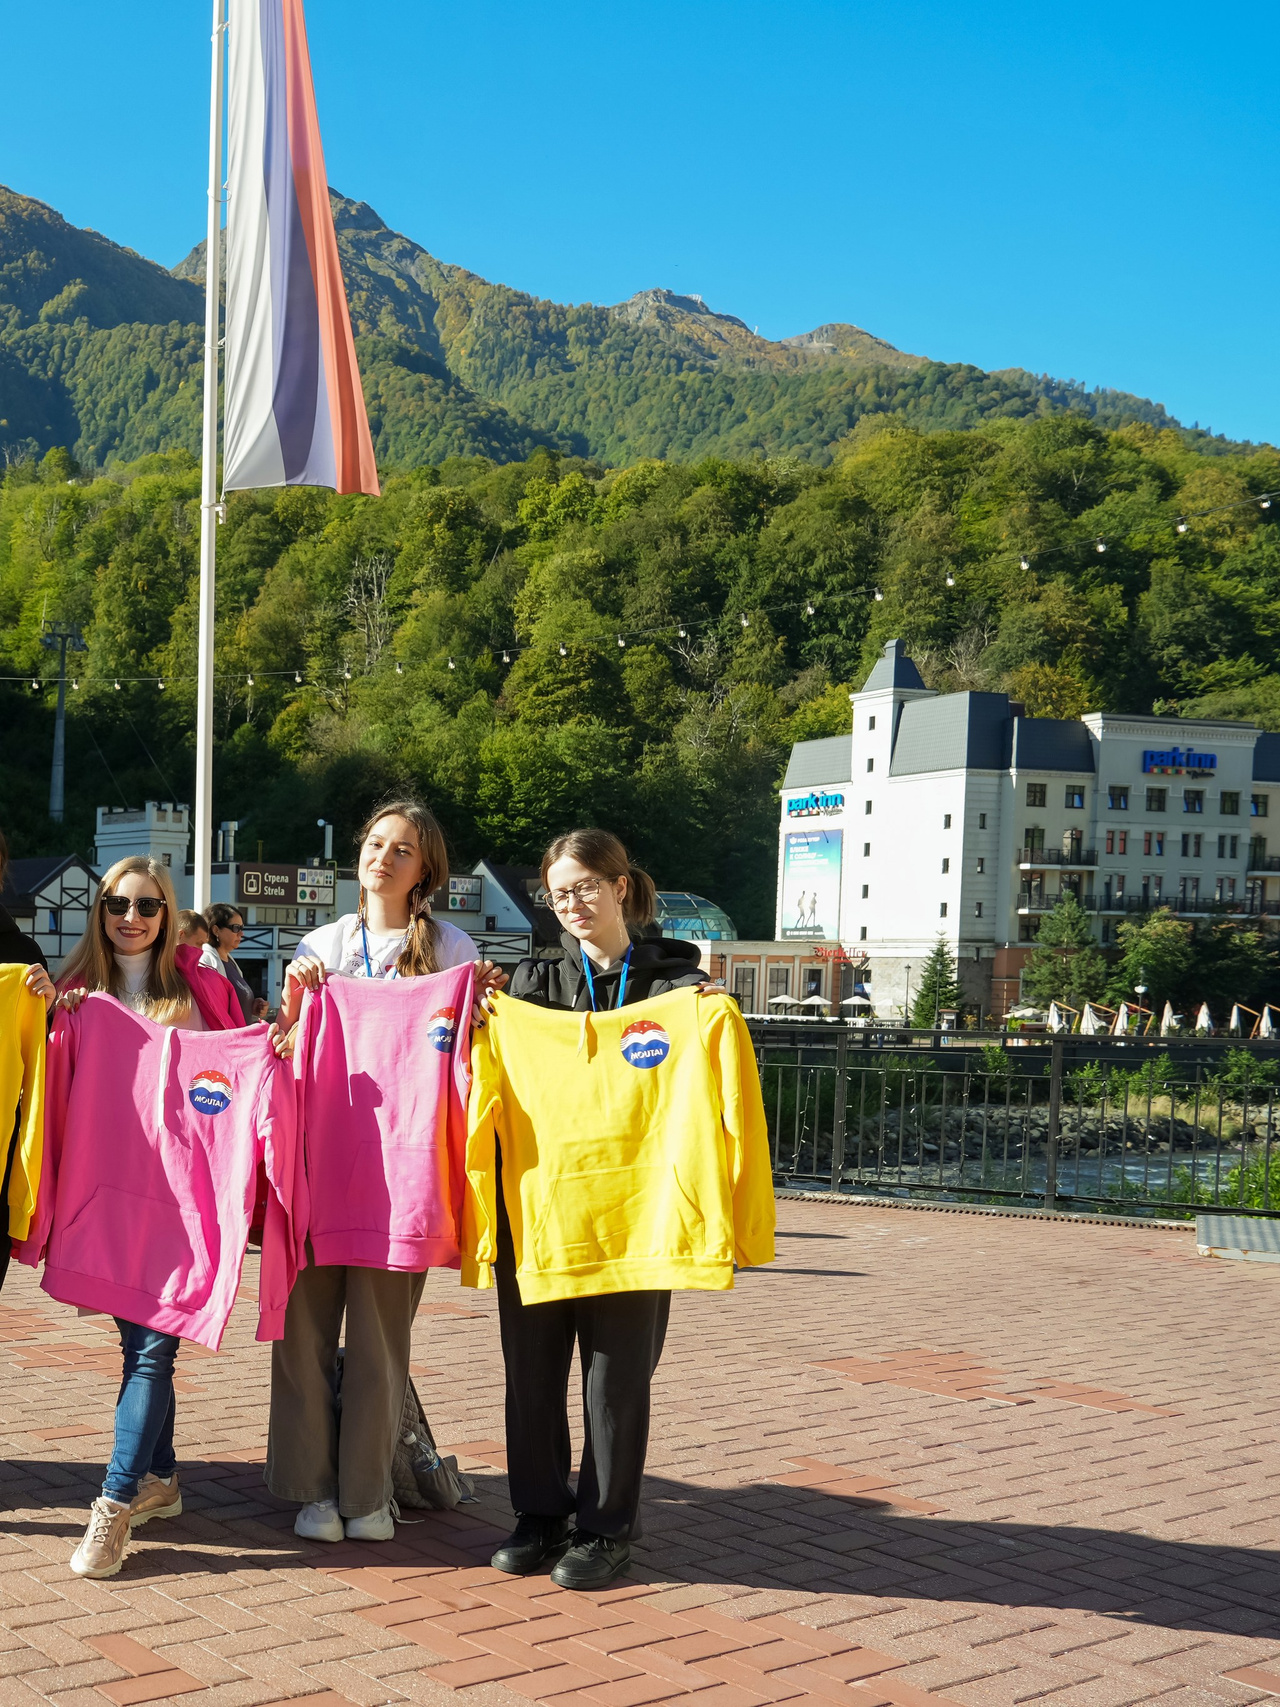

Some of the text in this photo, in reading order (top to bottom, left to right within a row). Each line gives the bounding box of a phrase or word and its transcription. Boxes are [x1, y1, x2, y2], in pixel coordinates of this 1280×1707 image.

[1143, 747, 1217, 773] park inn
[787, 793, 819, 815] park
[820, 790, 845, 808] inn
[263, 872, 289, 884] Стрела
[263, 885, 285, 896] Strela
[630, 1048, 664, 1061] MOUTAI
[194, 1094, 224, 1108] MOUTAI
